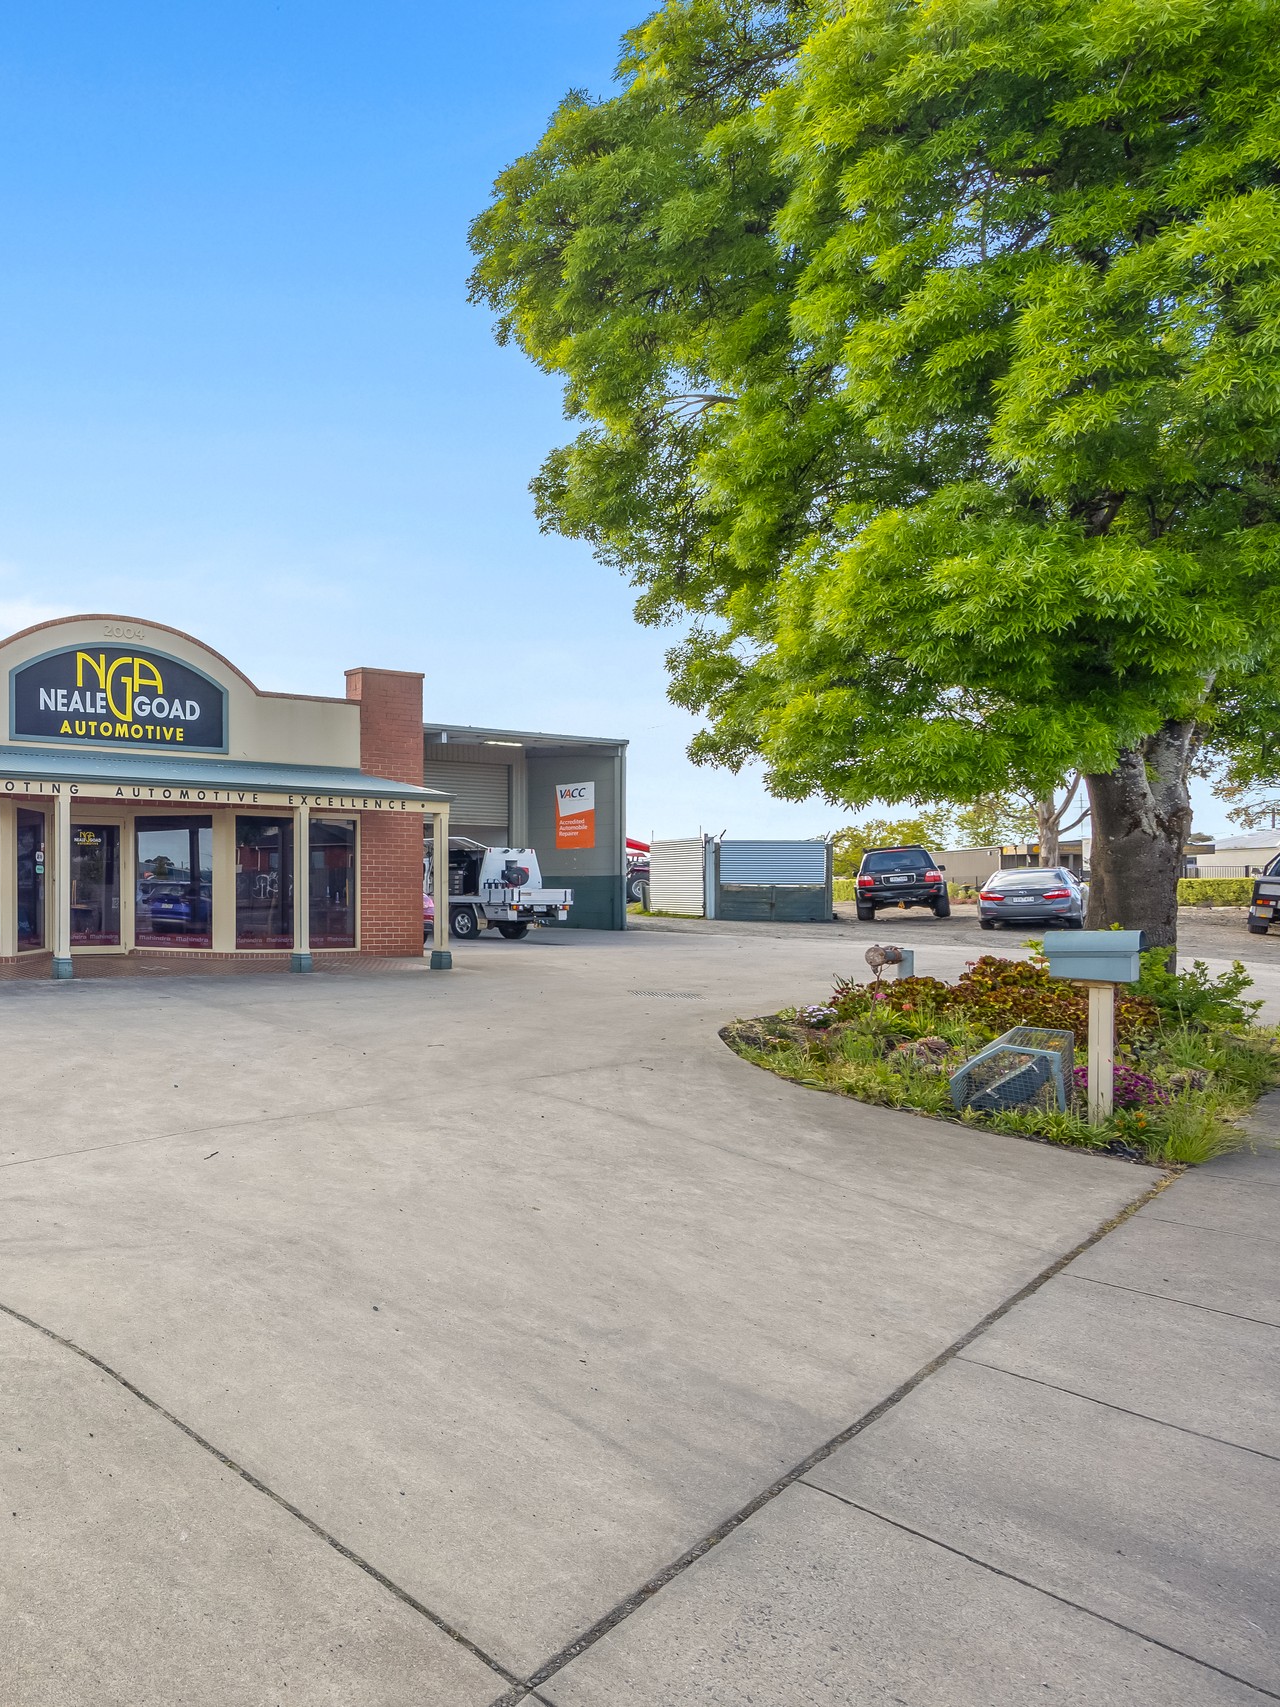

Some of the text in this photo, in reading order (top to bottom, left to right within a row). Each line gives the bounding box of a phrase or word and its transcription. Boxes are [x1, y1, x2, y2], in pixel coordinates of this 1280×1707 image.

[103, 625, 145, 640] 2004
[77, 652, 164, 722] NGA
[39, 688, 201, 721] NEALE GOAD
[59, 720, 185, 742] AUTOMOTIVE
[115, 786, 258, 803] AUTOMOTIVE
[288, 795, 407, 810] EXCELLENCE
[560, 787, 586, 799] VACC
